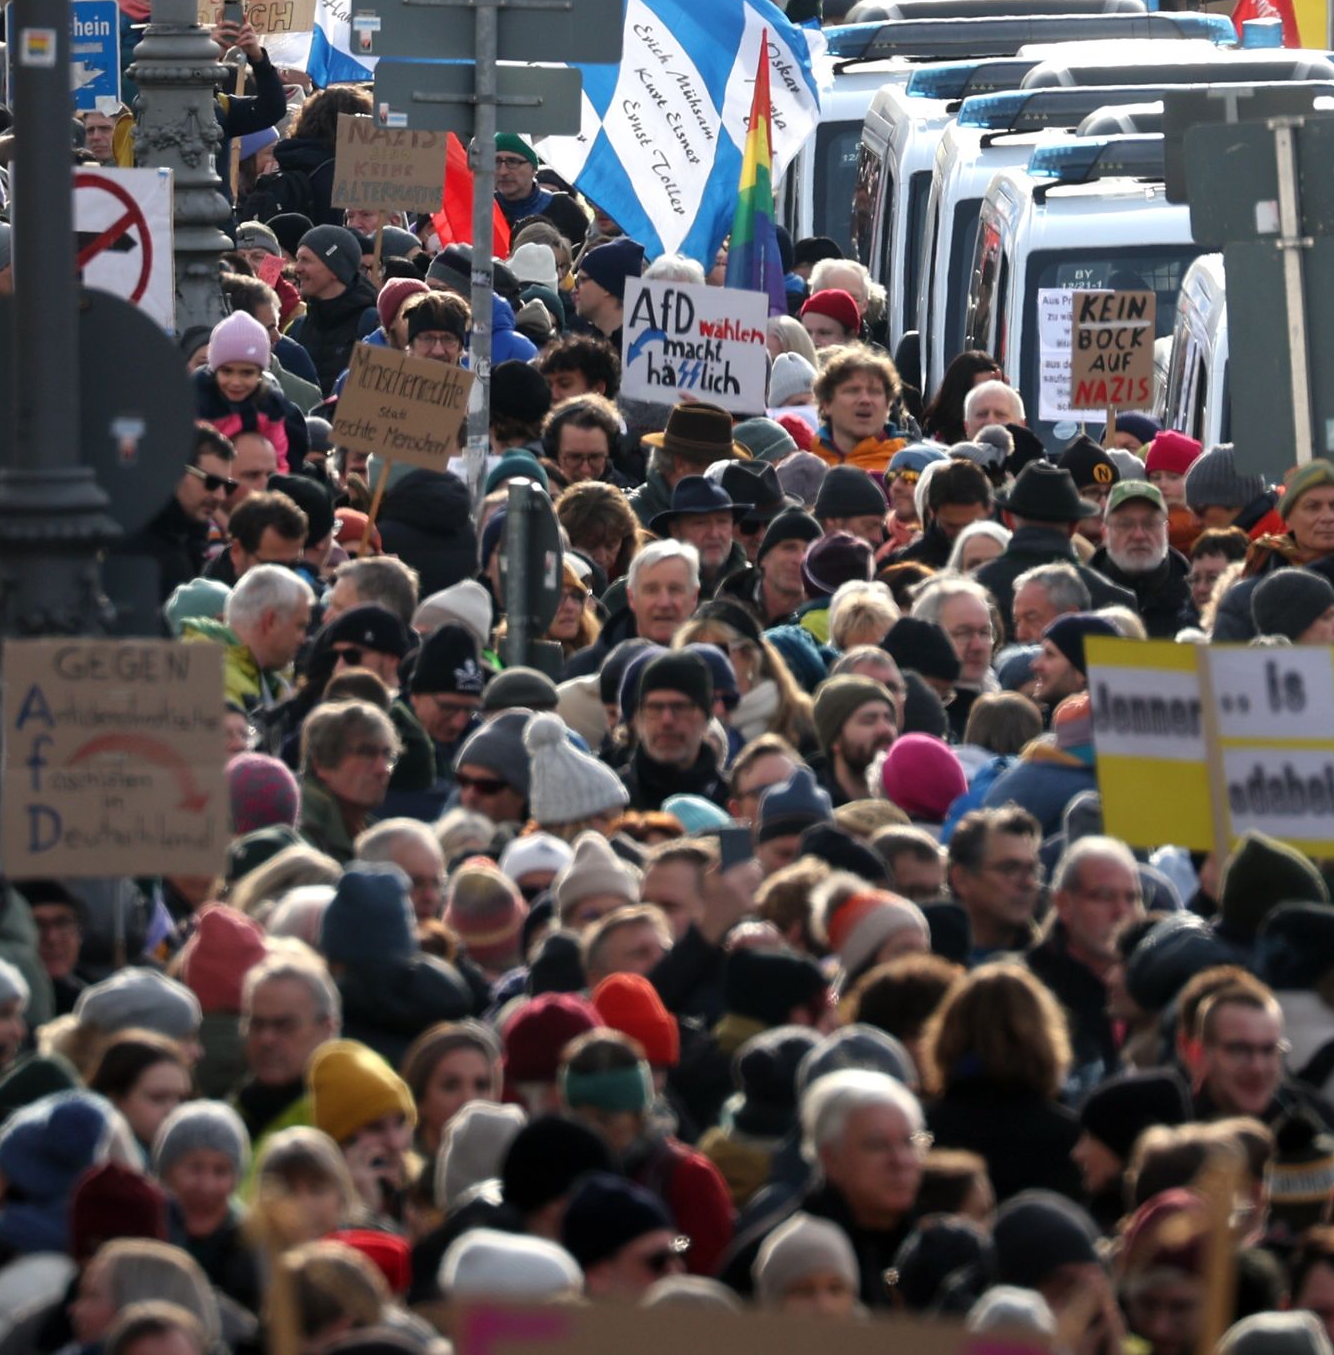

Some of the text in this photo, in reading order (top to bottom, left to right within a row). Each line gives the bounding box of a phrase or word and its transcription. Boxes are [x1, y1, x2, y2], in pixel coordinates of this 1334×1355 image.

[633, 23, 714, 141] Erich Mühsam
[767, 41, 801, 94] Oskar
[634, 67, 700, 165] Kurt Eisner
[623, 99, 686, 216] Ernst Toller
[1075, 269, 1093, 279] BY
[629, 286, 765, 345] AfD wählen
[1042, 297, 1060, 305] Aus
[1079, 295, 1147, 323] KEIN
[662, 334, 723, 364] macht
[1078, 327, 1147, 350] BOCK
[1088, 352, 1134, 373] AUF
[355, 348, 465, 409] Menschenrechte
[1074, 376, 1149, 406] NAZIS
[333, 418, 377, 441] rechte
[53, 646, 193, 683] GEGEN
